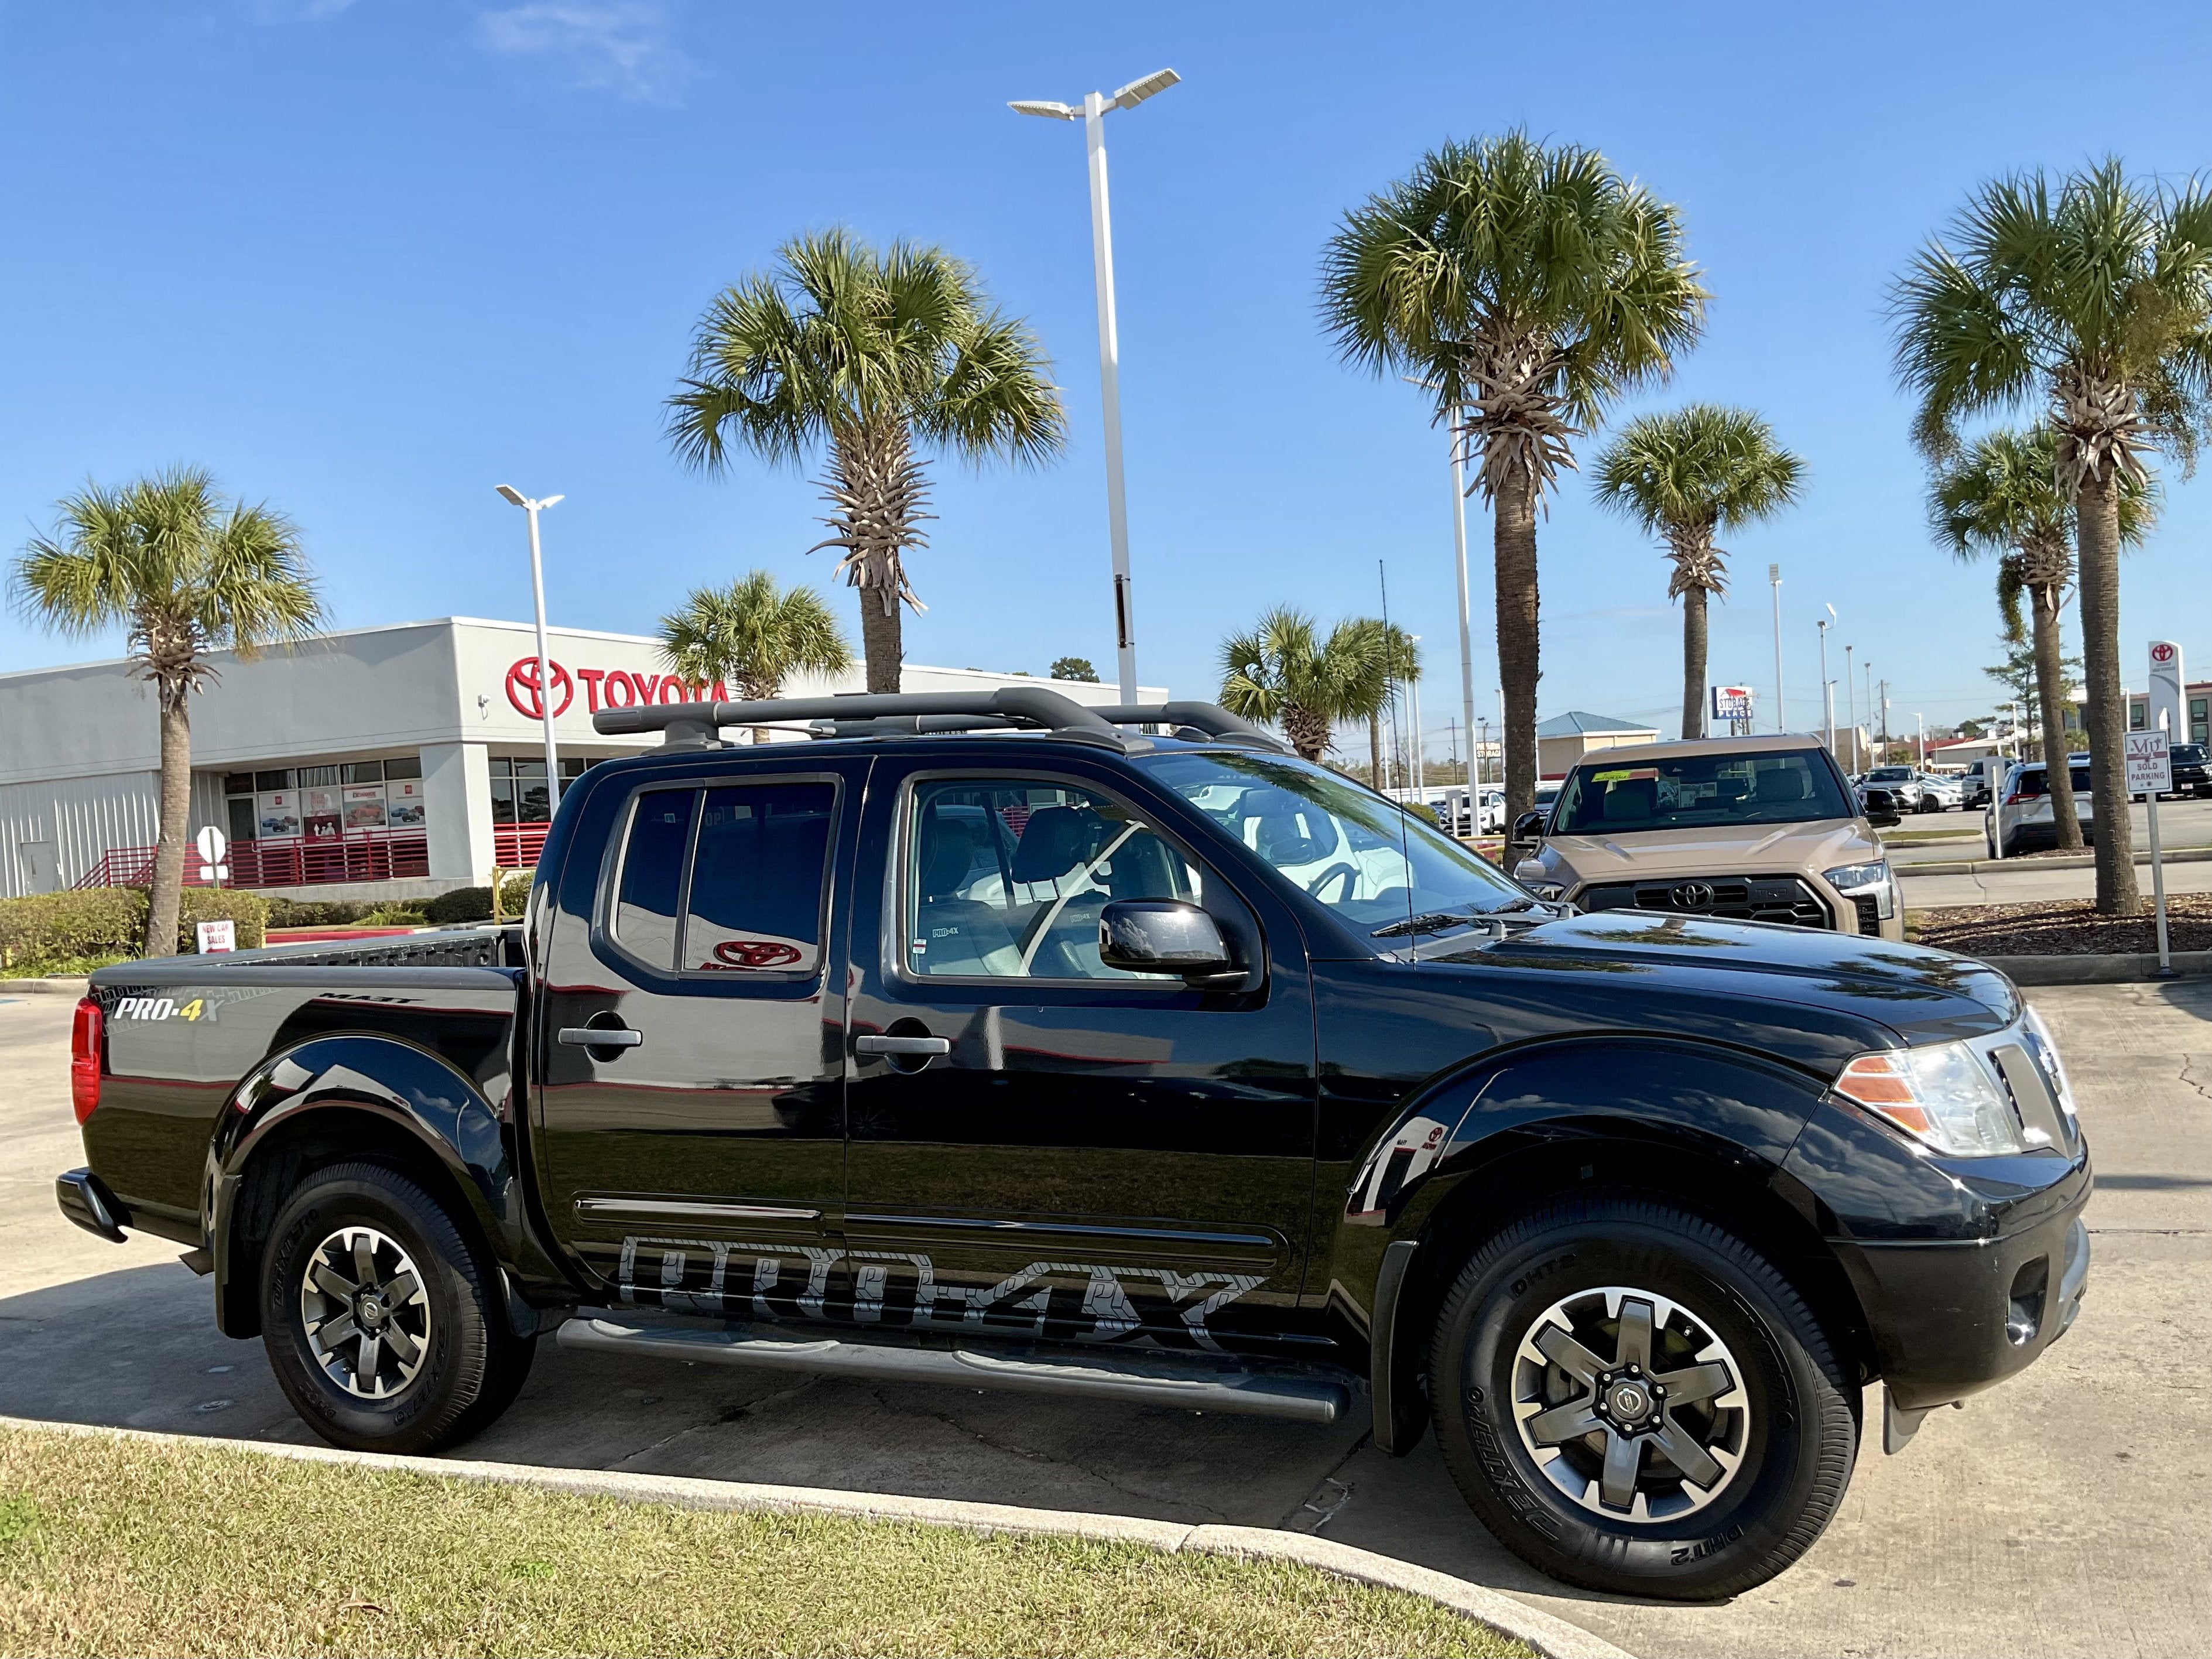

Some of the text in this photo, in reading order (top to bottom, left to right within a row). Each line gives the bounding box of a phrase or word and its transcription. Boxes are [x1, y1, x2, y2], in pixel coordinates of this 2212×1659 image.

[1719, 697, 1751, 709] STORA
[2137, 762, 2158, 771] SOLD
[2131, 772, 2165, 781] PARKING
[203, 923, 229, 933] NEW CAR
[932, 926, 959, 938] PRO-4X
[207, 935, 225, 945] SALES
[114, 997, 225, 1021] PRO-4X
[1670, 1523, 1744, 1566] DHT2
